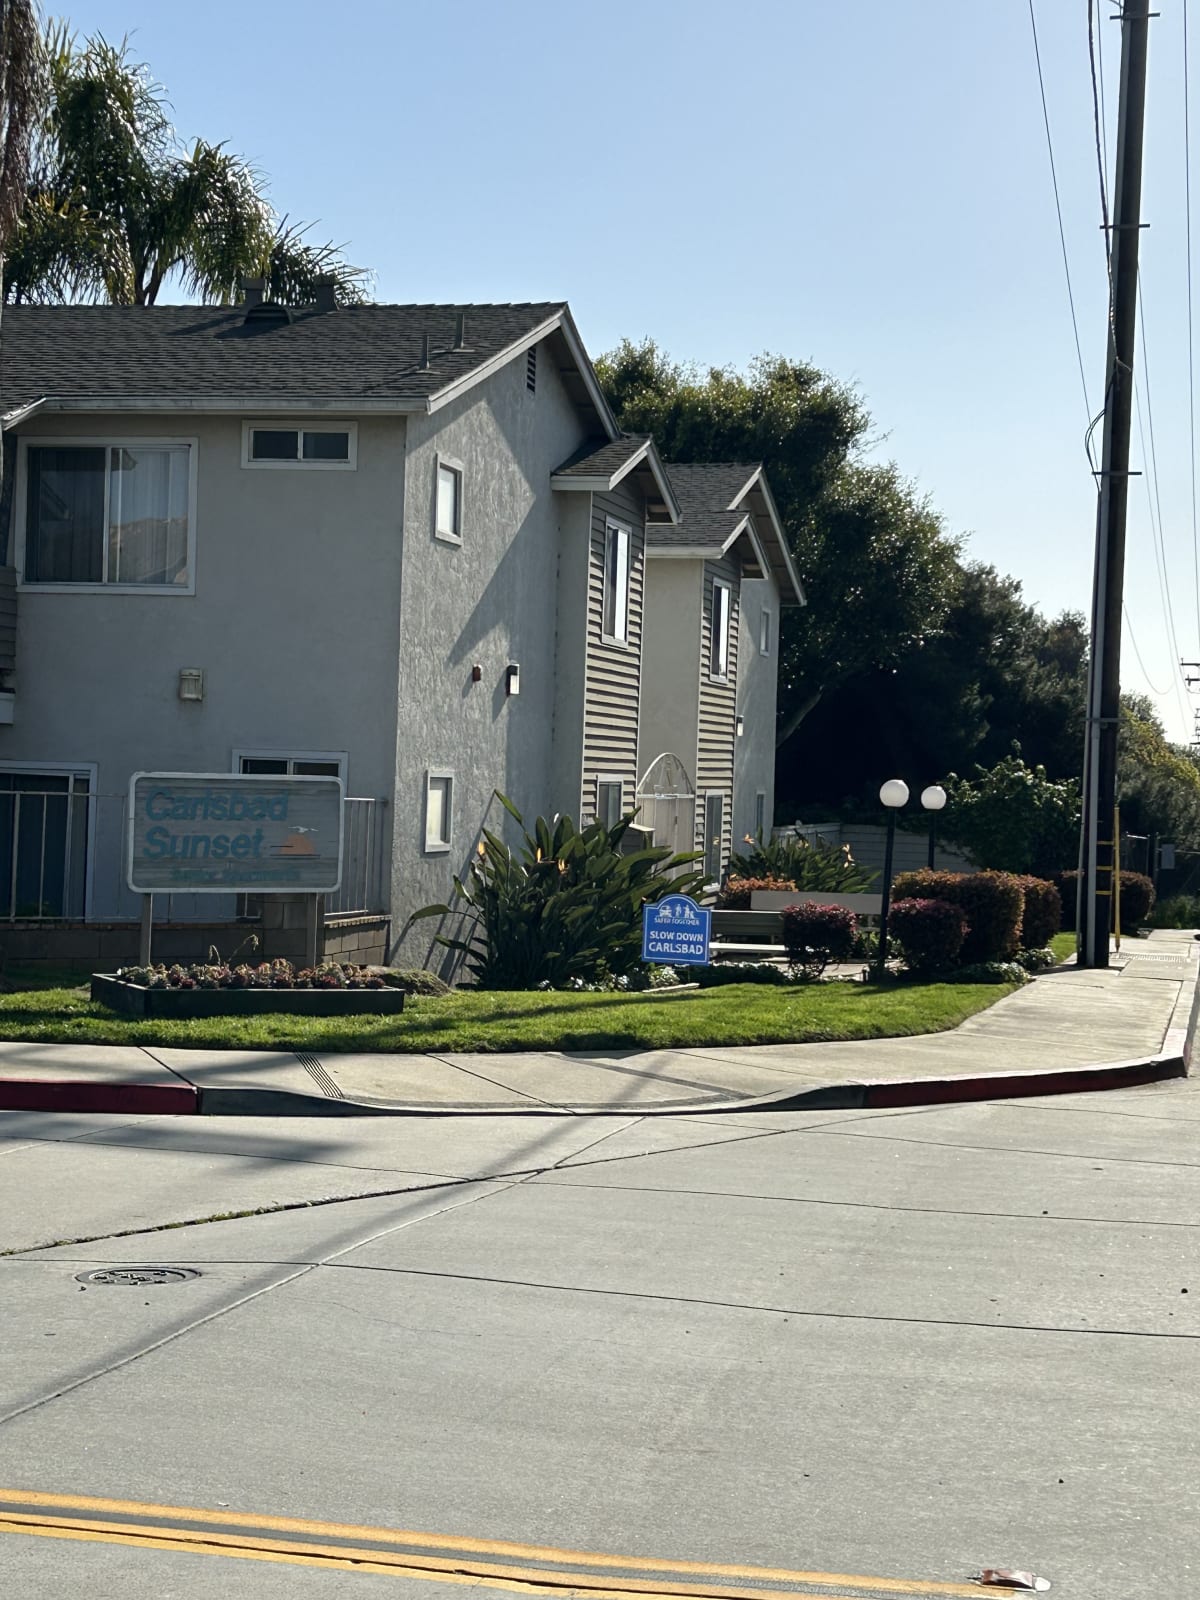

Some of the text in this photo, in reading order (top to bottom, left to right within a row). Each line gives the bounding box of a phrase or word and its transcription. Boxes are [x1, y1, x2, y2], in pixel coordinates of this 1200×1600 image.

[145, 787, 288, 821] Carlsbad
[143, 826, 264, 858] Sunset
[649, 930, 704, 942] SLOW DOWN
[648, 942, 704, 955] CARLSBAD
